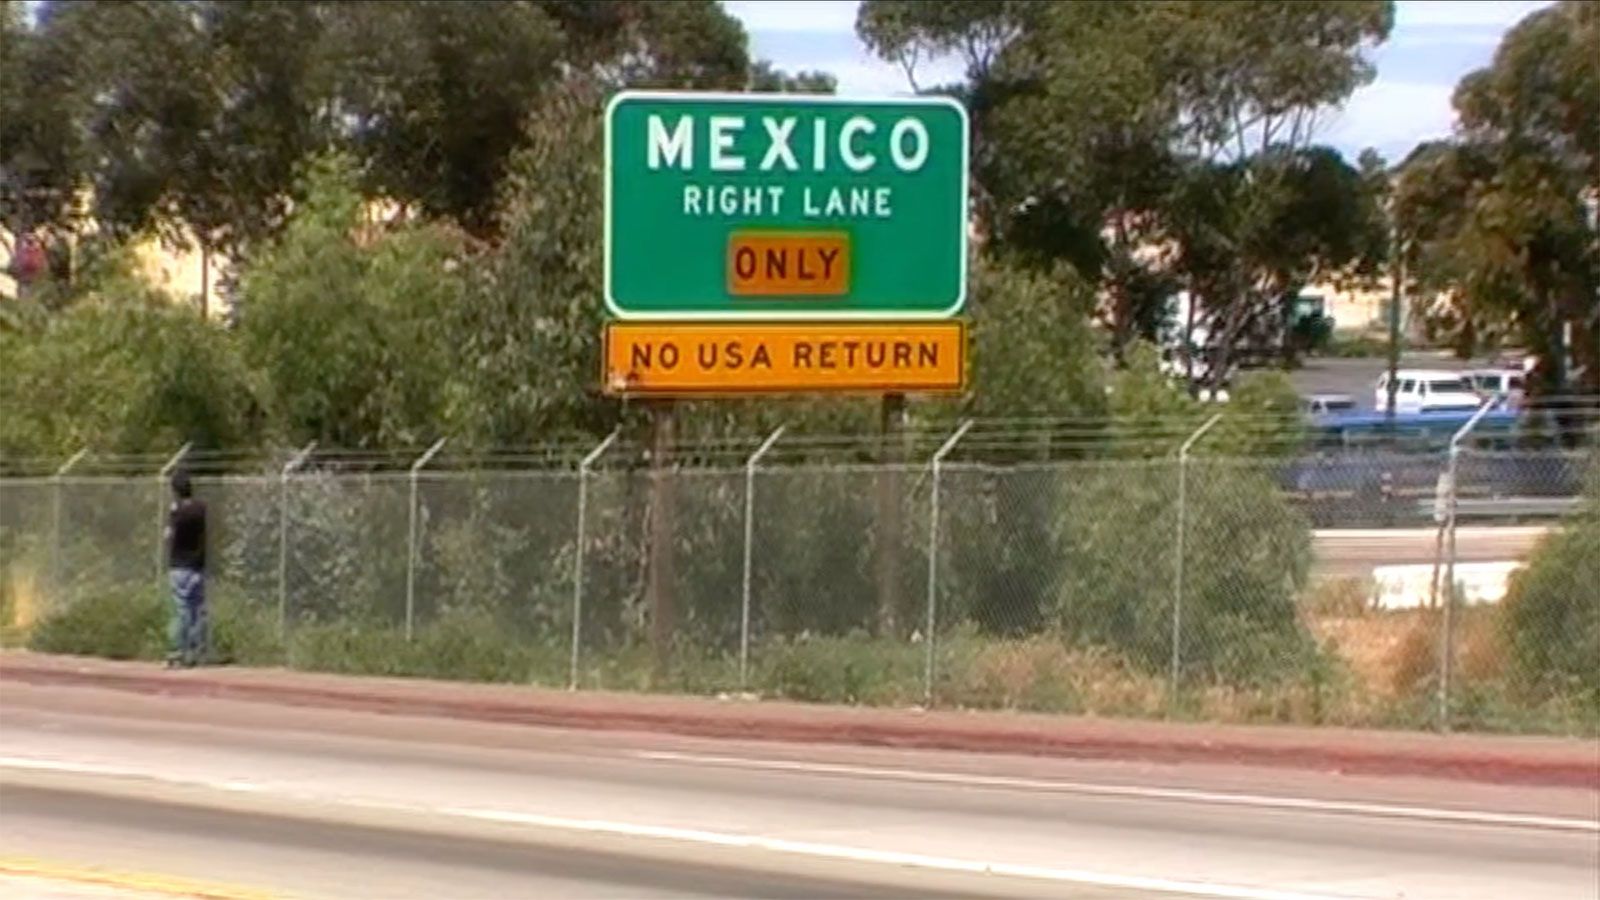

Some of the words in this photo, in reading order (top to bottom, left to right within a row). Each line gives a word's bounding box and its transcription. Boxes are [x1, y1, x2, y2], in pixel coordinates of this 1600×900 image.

[647, 115, 929, 171] MEXICO
[684, 186, 784, 215] RIGHT
[803, 187, 892, 217] LANE
[735, 247, 839, 280] ONLY
[631, 343, 679, 369] NO
[698, 343, 772, 369] USA
[793, 342, 938, 368] RETURN
